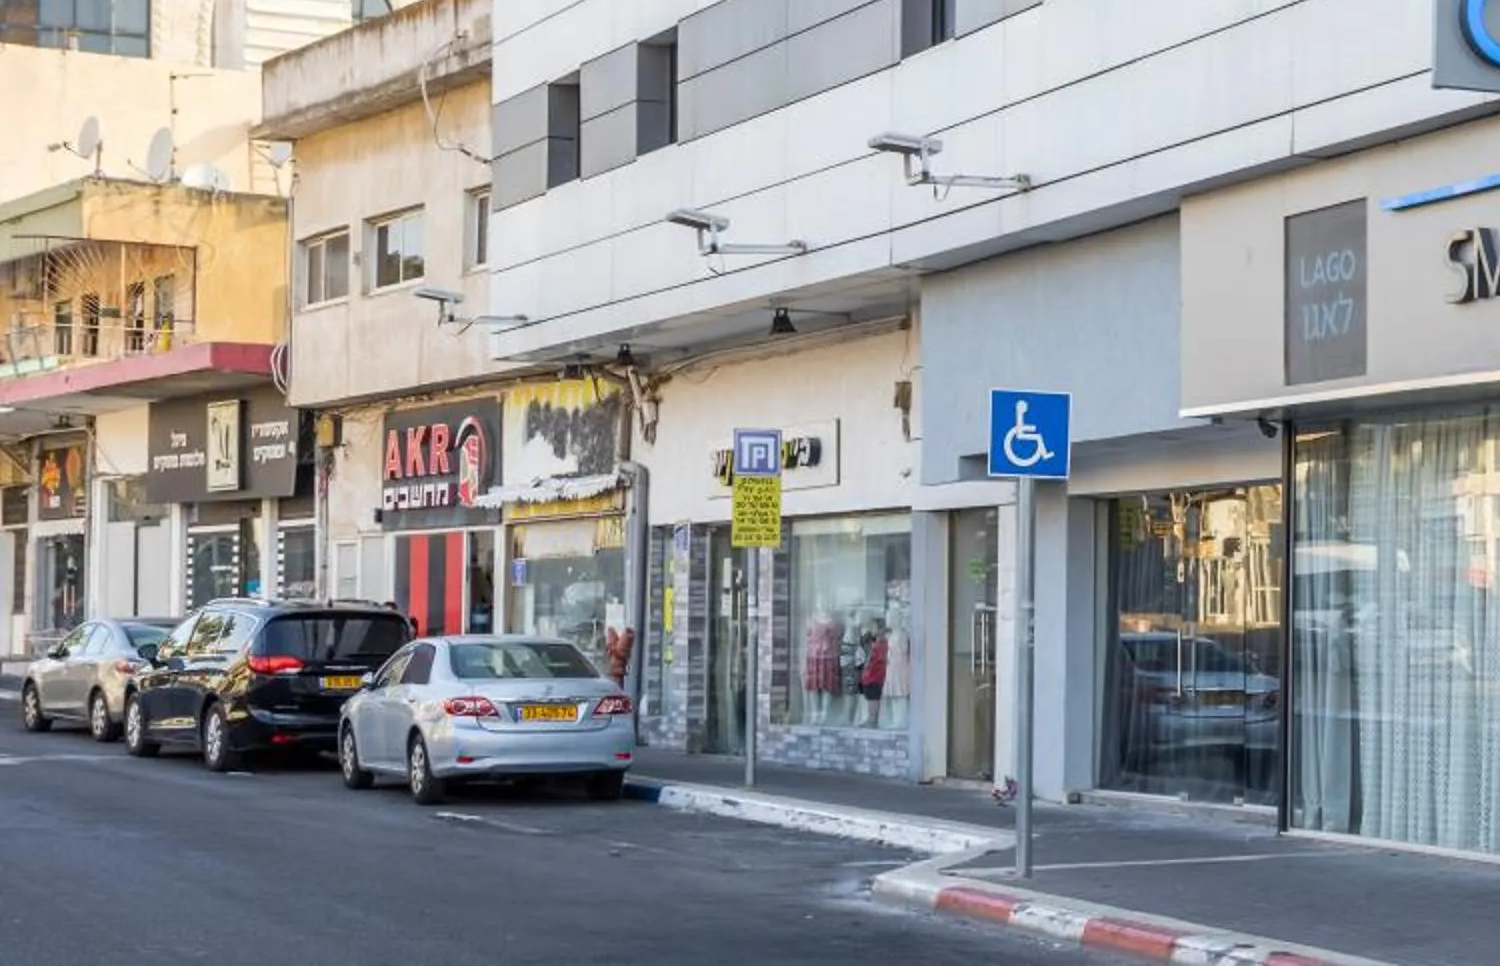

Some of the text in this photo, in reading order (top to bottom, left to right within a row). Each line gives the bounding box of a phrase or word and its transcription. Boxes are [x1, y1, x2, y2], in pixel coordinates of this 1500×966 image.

[1301, 248, 1356, 290] LAGO
[384, 423, 450, 481] AKR
[383, 482, 449, 511] מחשבים
